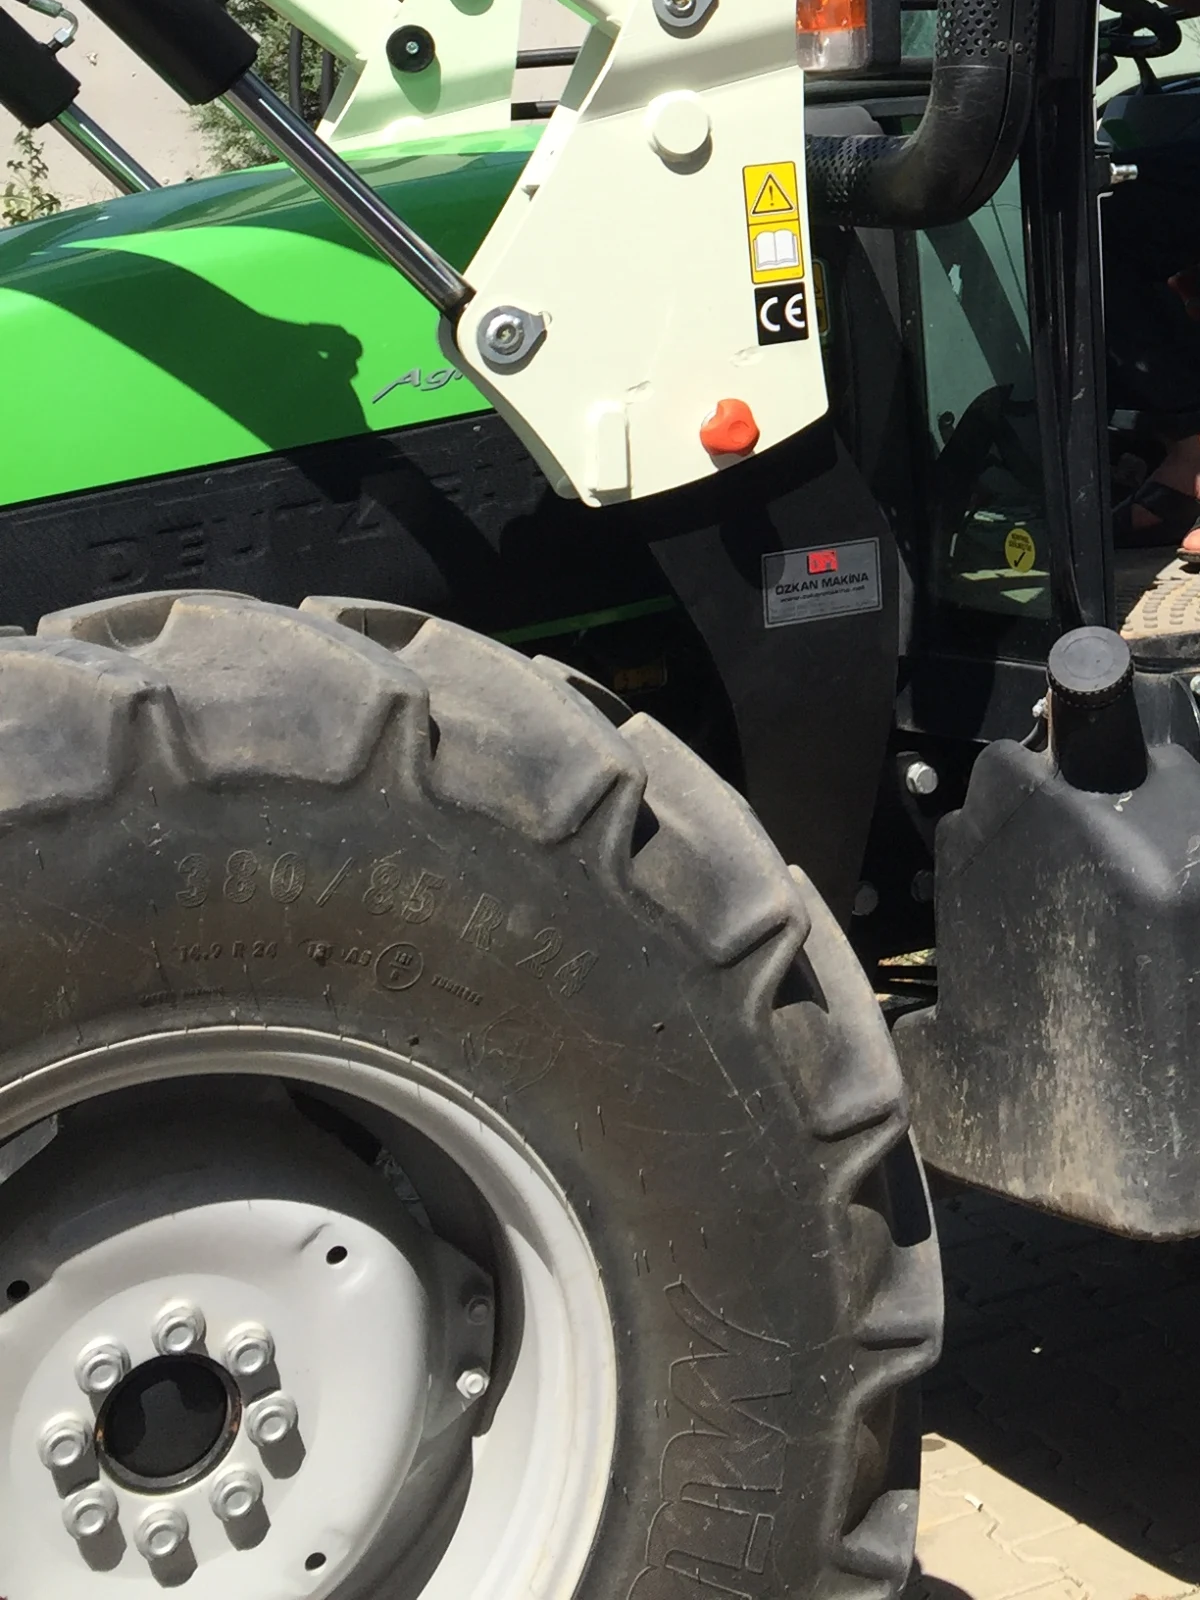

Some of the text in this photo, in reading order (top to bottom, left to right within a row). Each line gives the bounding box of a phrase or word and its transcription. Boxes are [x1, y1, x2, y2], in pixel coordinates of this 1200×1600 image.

[760, 292, 806, 332] CE
[175, 849, 600, 997] 380/85 R 24
[250, 940, 278, 960] 24
